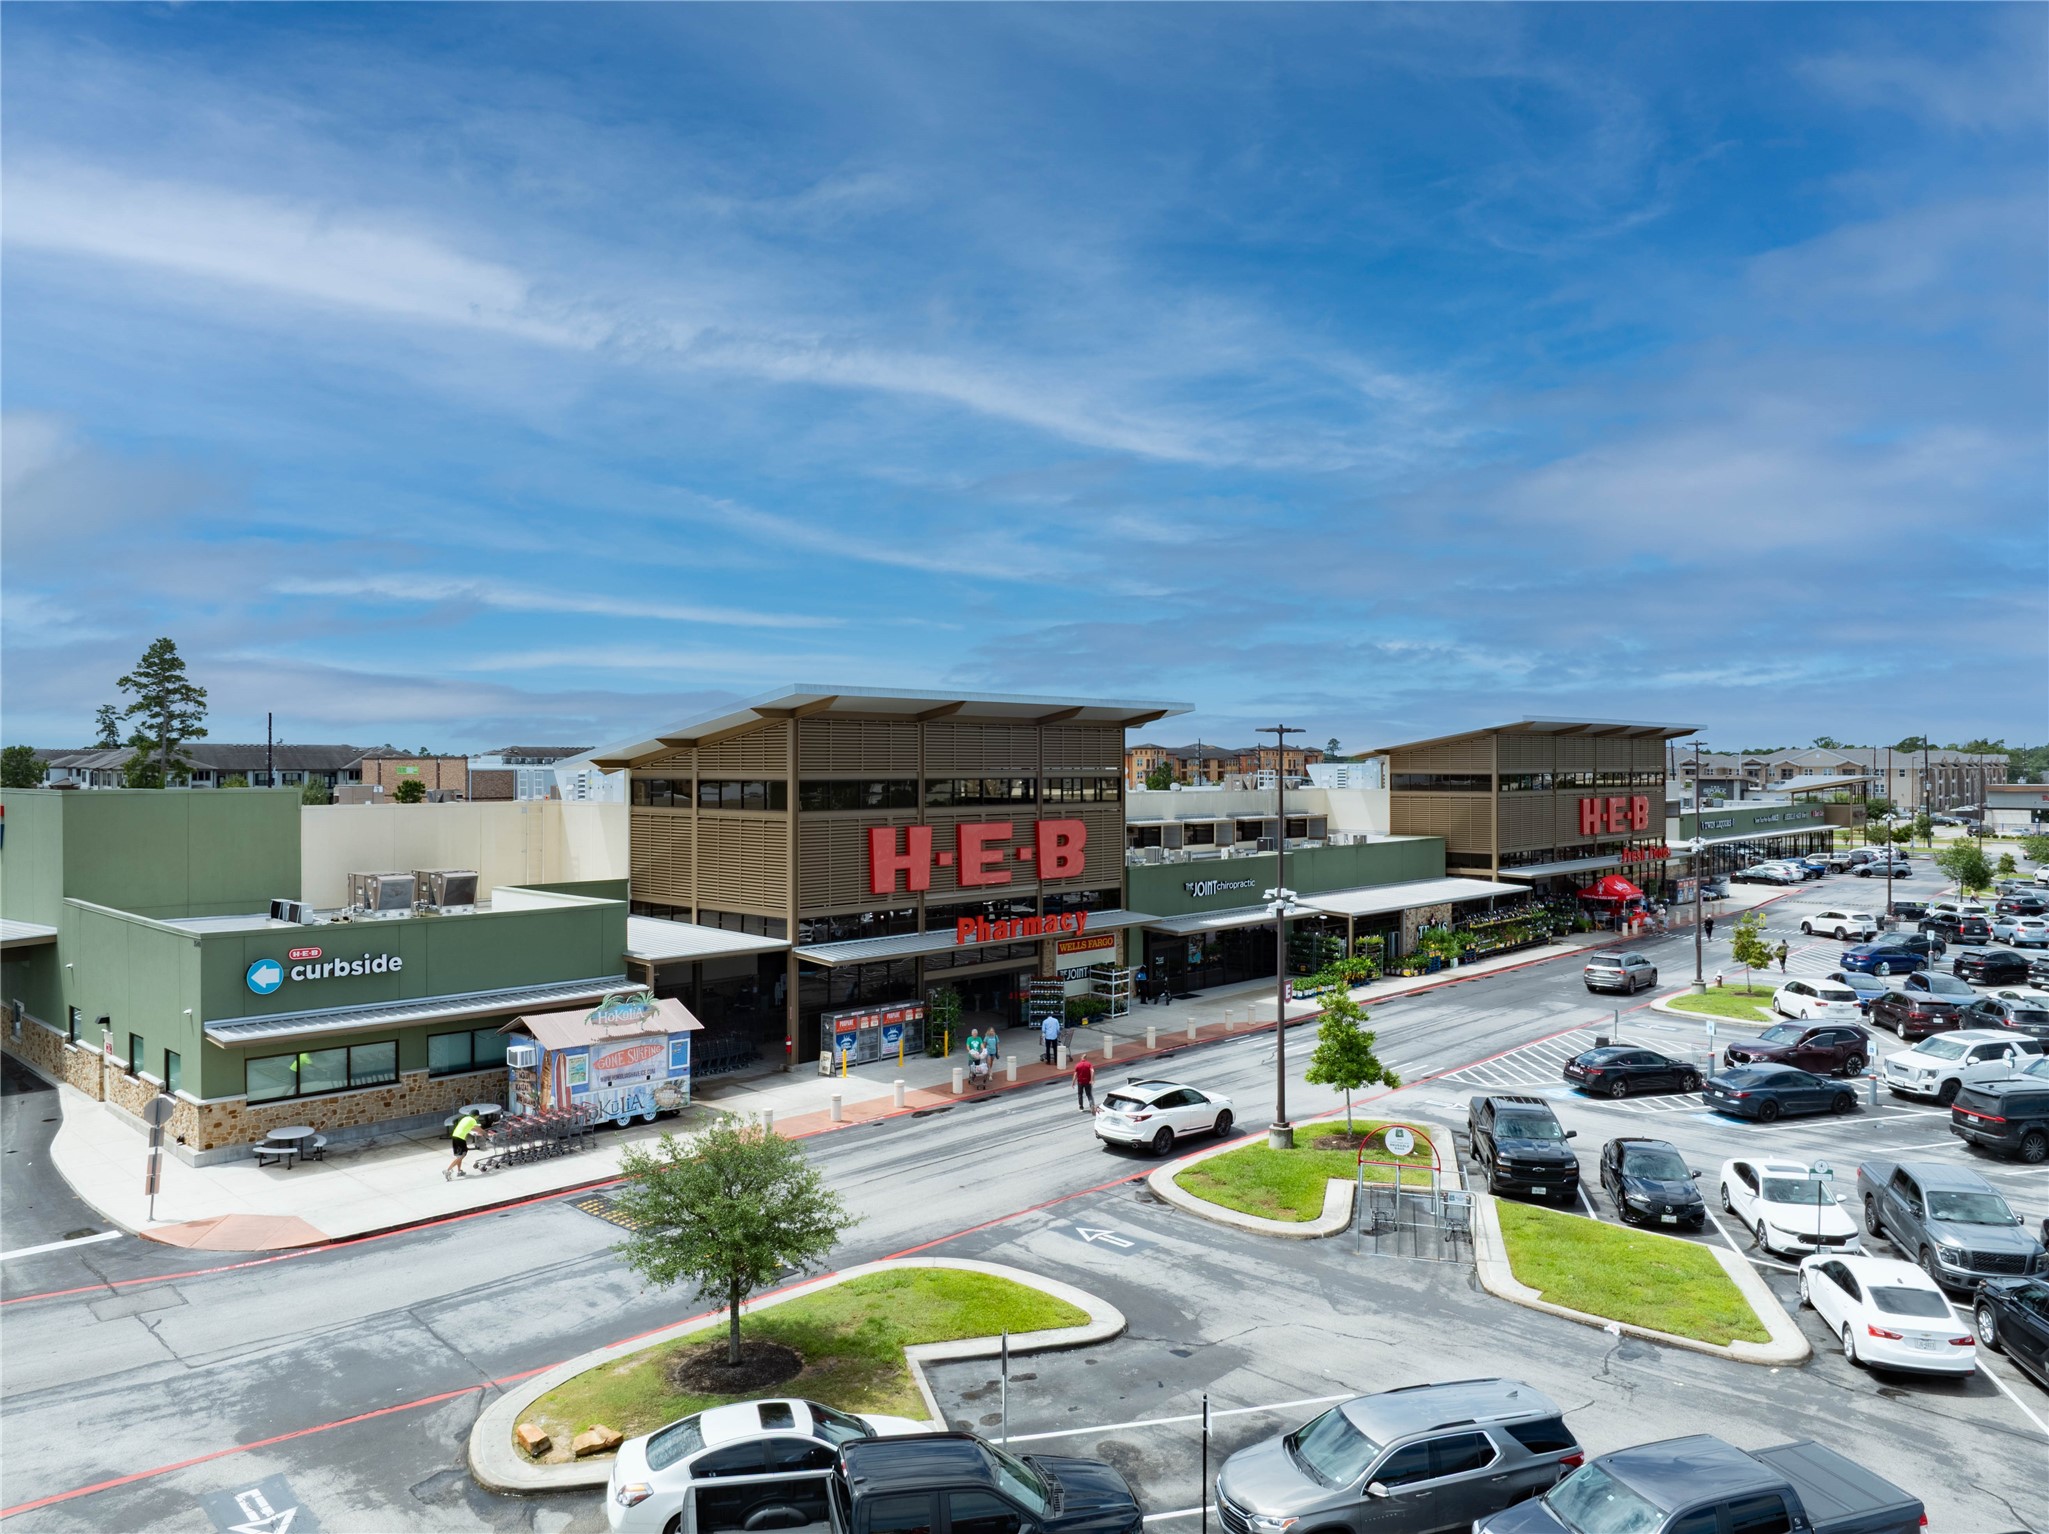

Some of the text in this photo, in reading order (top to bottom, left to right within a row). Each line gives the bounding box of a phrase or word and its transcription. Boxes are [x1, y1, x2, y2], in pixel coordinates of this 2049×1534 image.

[1579, 795, 1649, 835] H-E-B
[868, 819, 1087, 894] H-E-B
[1621, 843, 1671, 864] Fresh Foods
[1193, 880, 1217, 897] JOINT
[1217, 878, 1256, 891] chiropractic
[956, 910, 1088, 945] Pharmacy
[291, 949, 320, 958] H-E-B
[1059, 937, 1114, 953] WELLS FARGO
[290, 953, 403, 981] curbside
[1066, 967, 1088, 980] JOINT
[597, 1051, 625, 1070] GONE
[626, 1045, 662, 1064] SURFING
